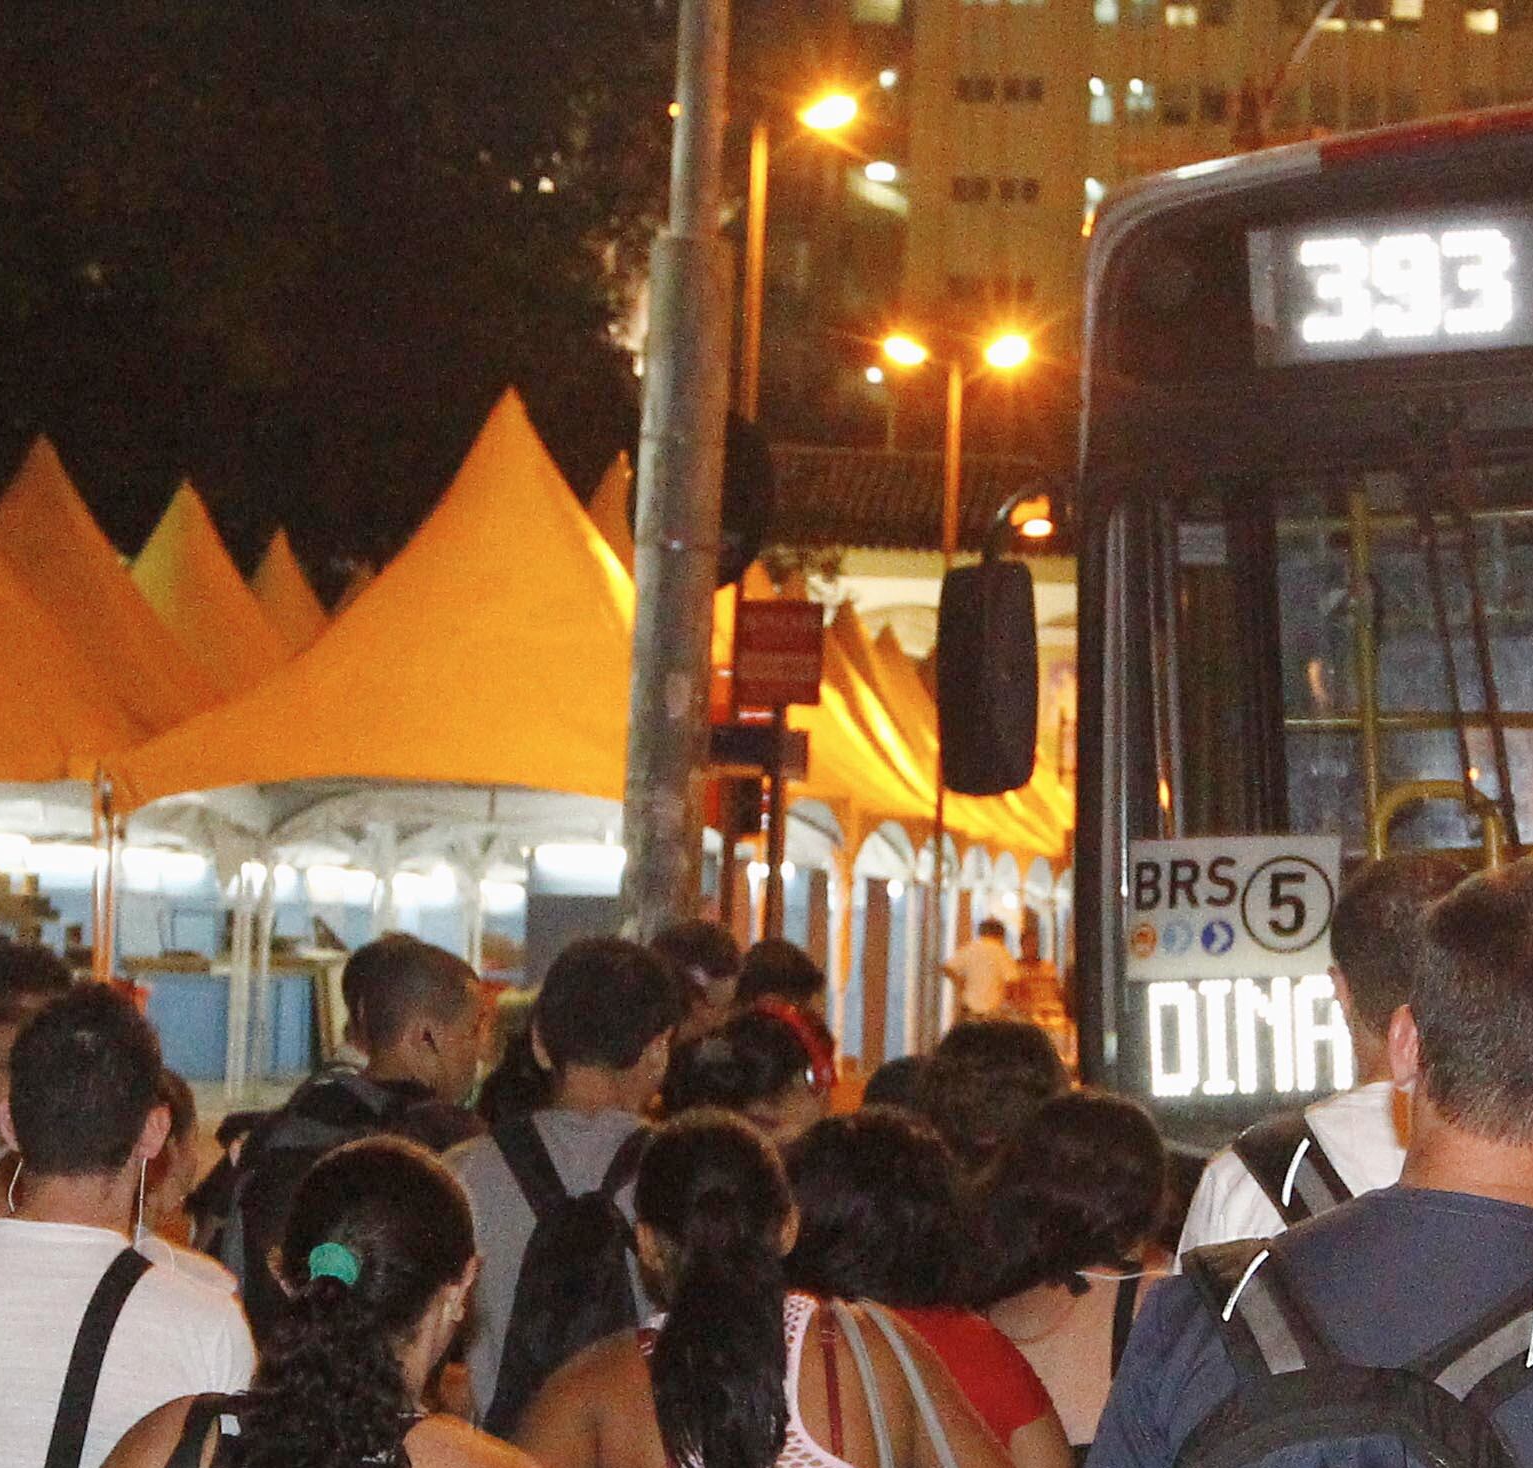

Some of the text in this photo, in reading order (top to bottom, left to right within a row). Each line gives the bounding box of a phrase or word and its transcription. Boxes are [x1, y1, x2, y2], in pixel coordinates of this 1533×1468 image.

[1300, 229, 1514, 344] 393
[1134, 855, 1308, 937] BRS 5
